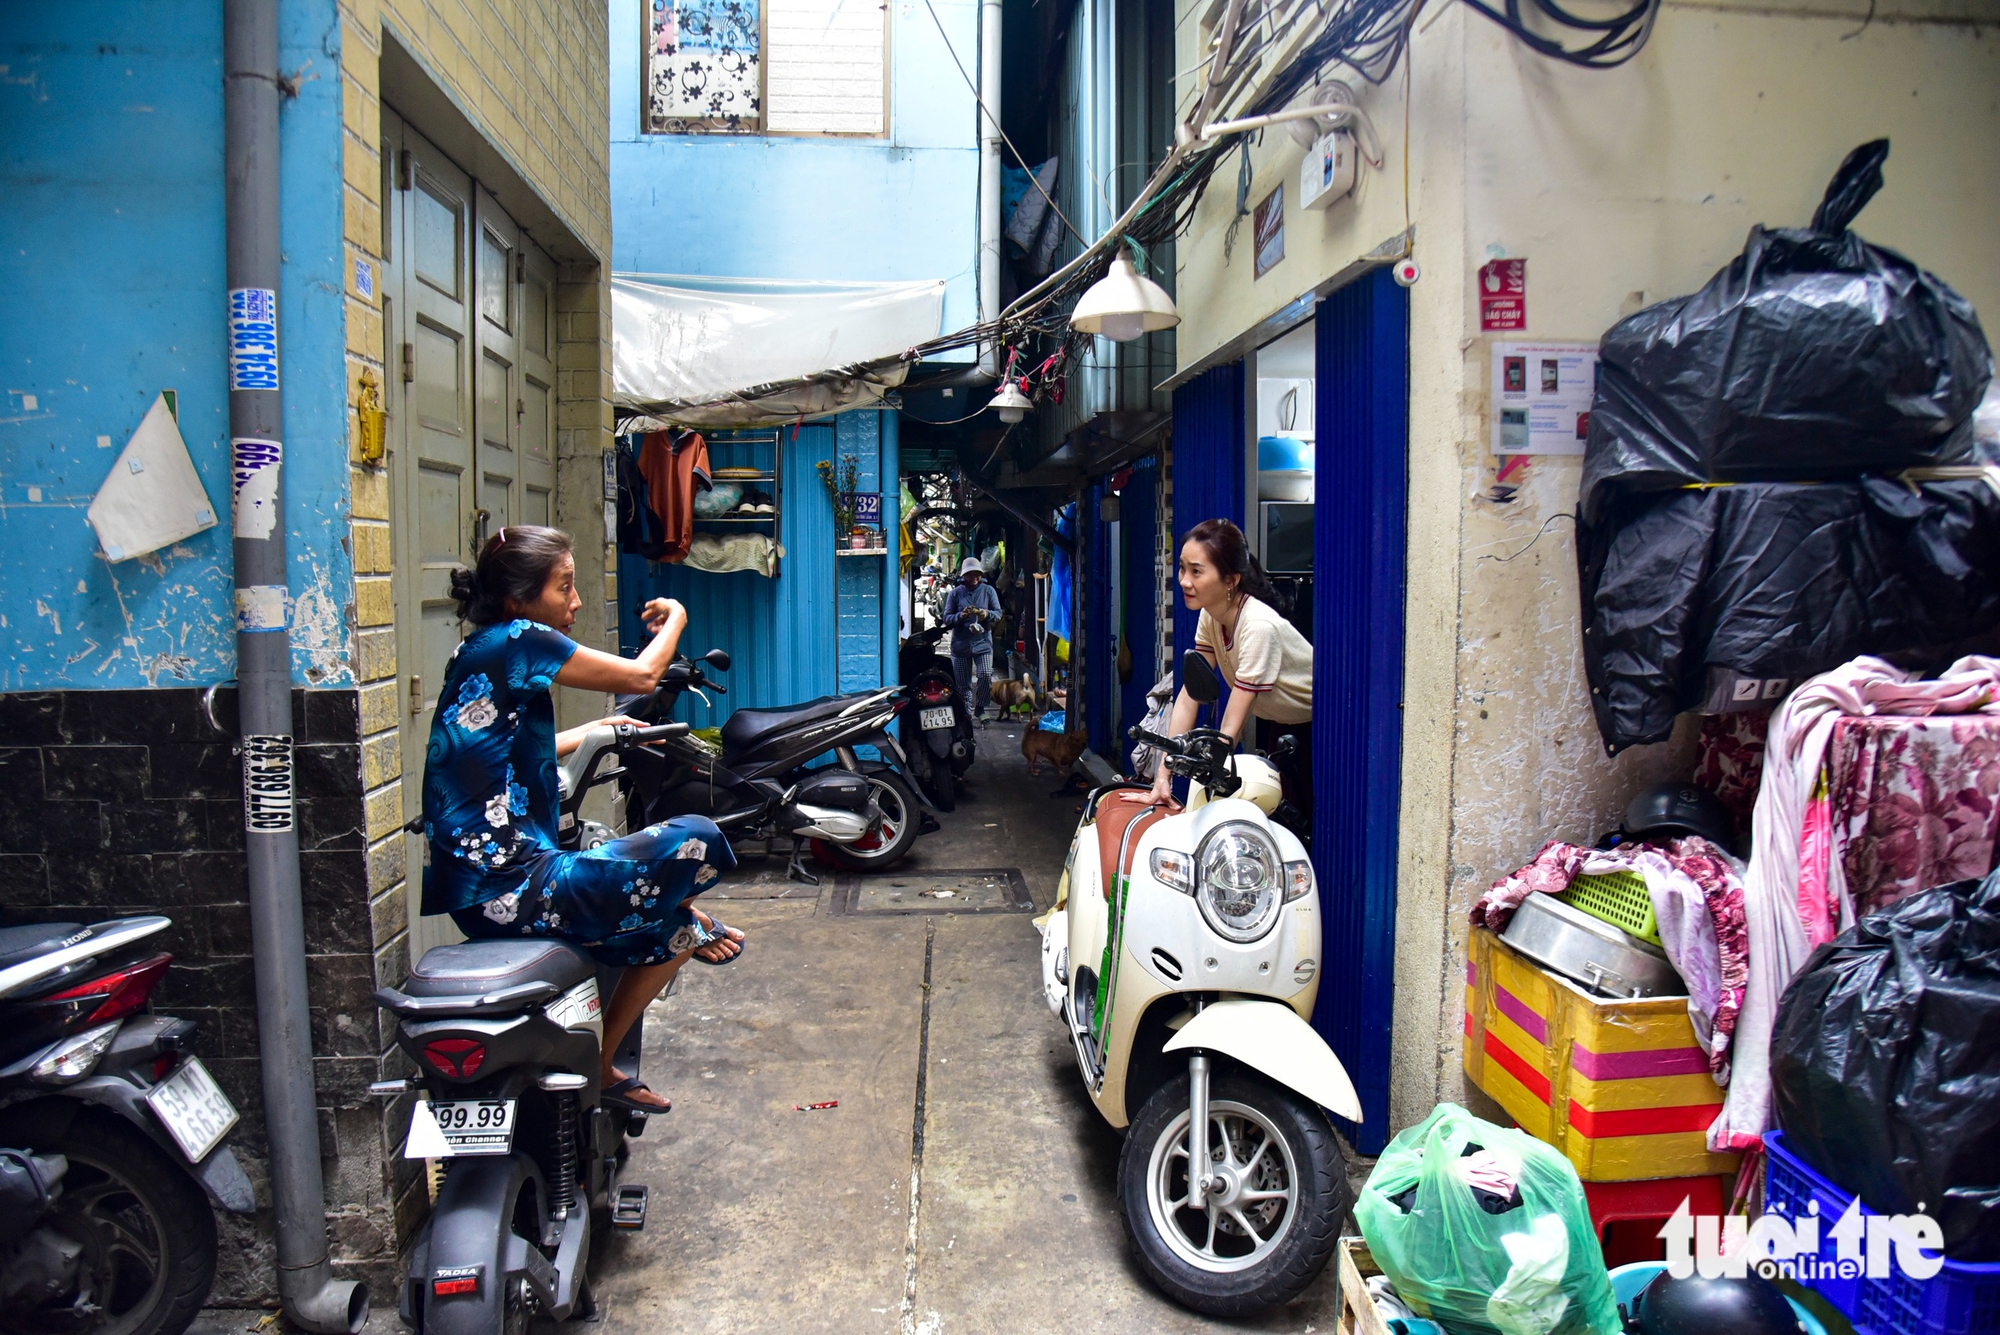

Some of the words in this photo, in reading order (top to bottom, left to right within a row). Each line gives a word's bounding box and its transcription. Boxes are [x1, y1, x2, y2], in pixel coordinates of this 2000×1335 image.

[1484, 310, 1500, 320] BÁO
[1501, 310, 1521, 320] CHÁY
[924, 708, 947, 719] 70-01
[923, 716, 953, 729] 414.95
[250, 736, 291, 829] 0977.686.362
[178, 1091, 233, 1153] 466.59
[434, 1107, 506, 1129] 99.99
[465, 1135, 505, 1143] Channel
[437, 1268, 478, 1277] YADEA
